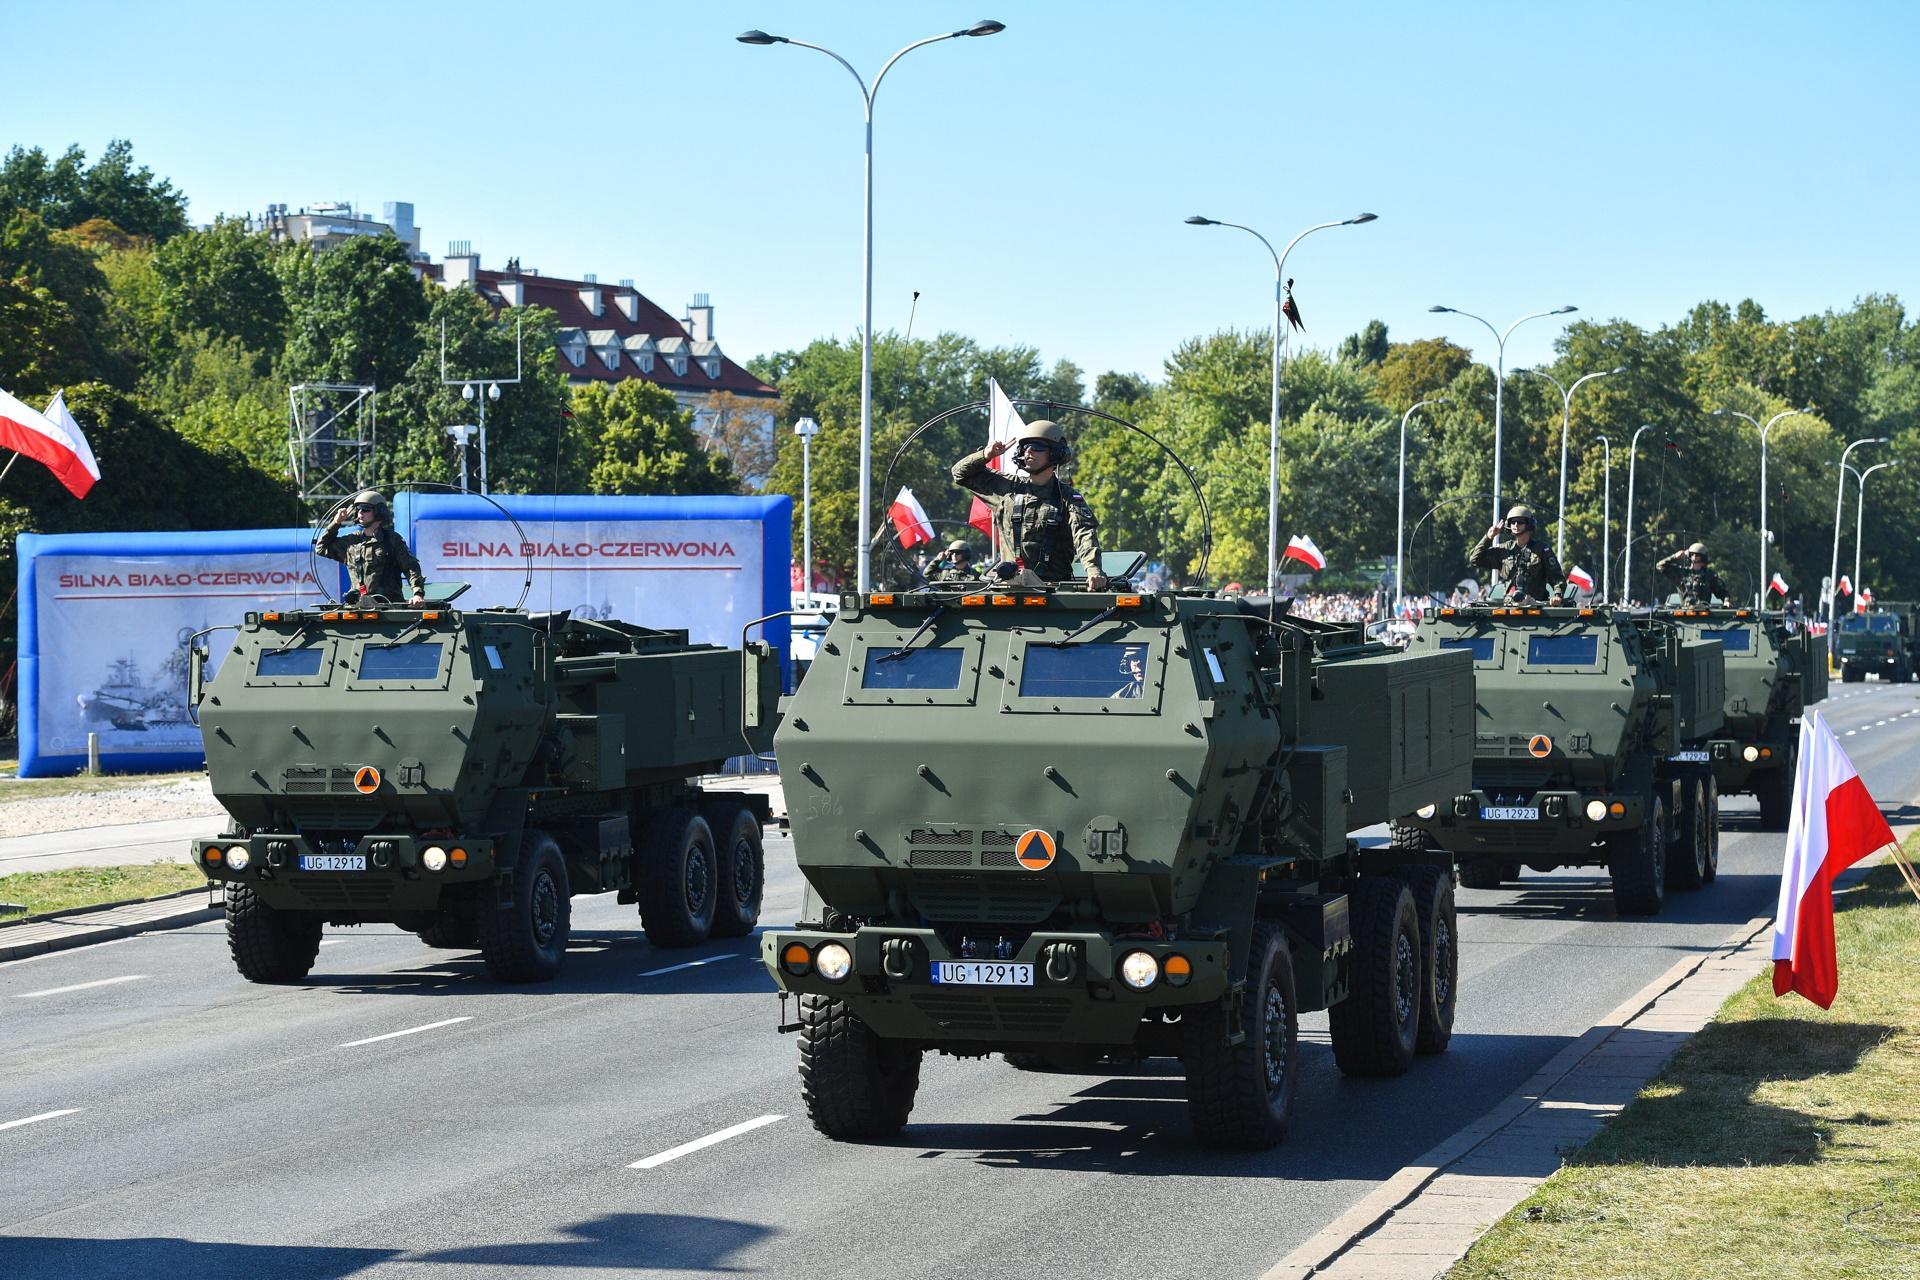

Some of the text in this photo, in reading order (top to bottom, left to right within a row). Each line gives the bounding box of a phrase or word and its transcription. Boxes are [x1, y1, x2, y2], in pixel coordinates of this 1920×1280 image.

[442, 541, 736, 557] SILNA BIAŁO-CZERWONA
[59, 571, 316, 588] SILNA BIAŁO-CZERWONA
[1487, 808, 1536, 819] UG 12923
[307, 857, 323, 869] UG
[327, 857, 363, 869] 12912
[943, 964, 1029, 984] UG 12913
